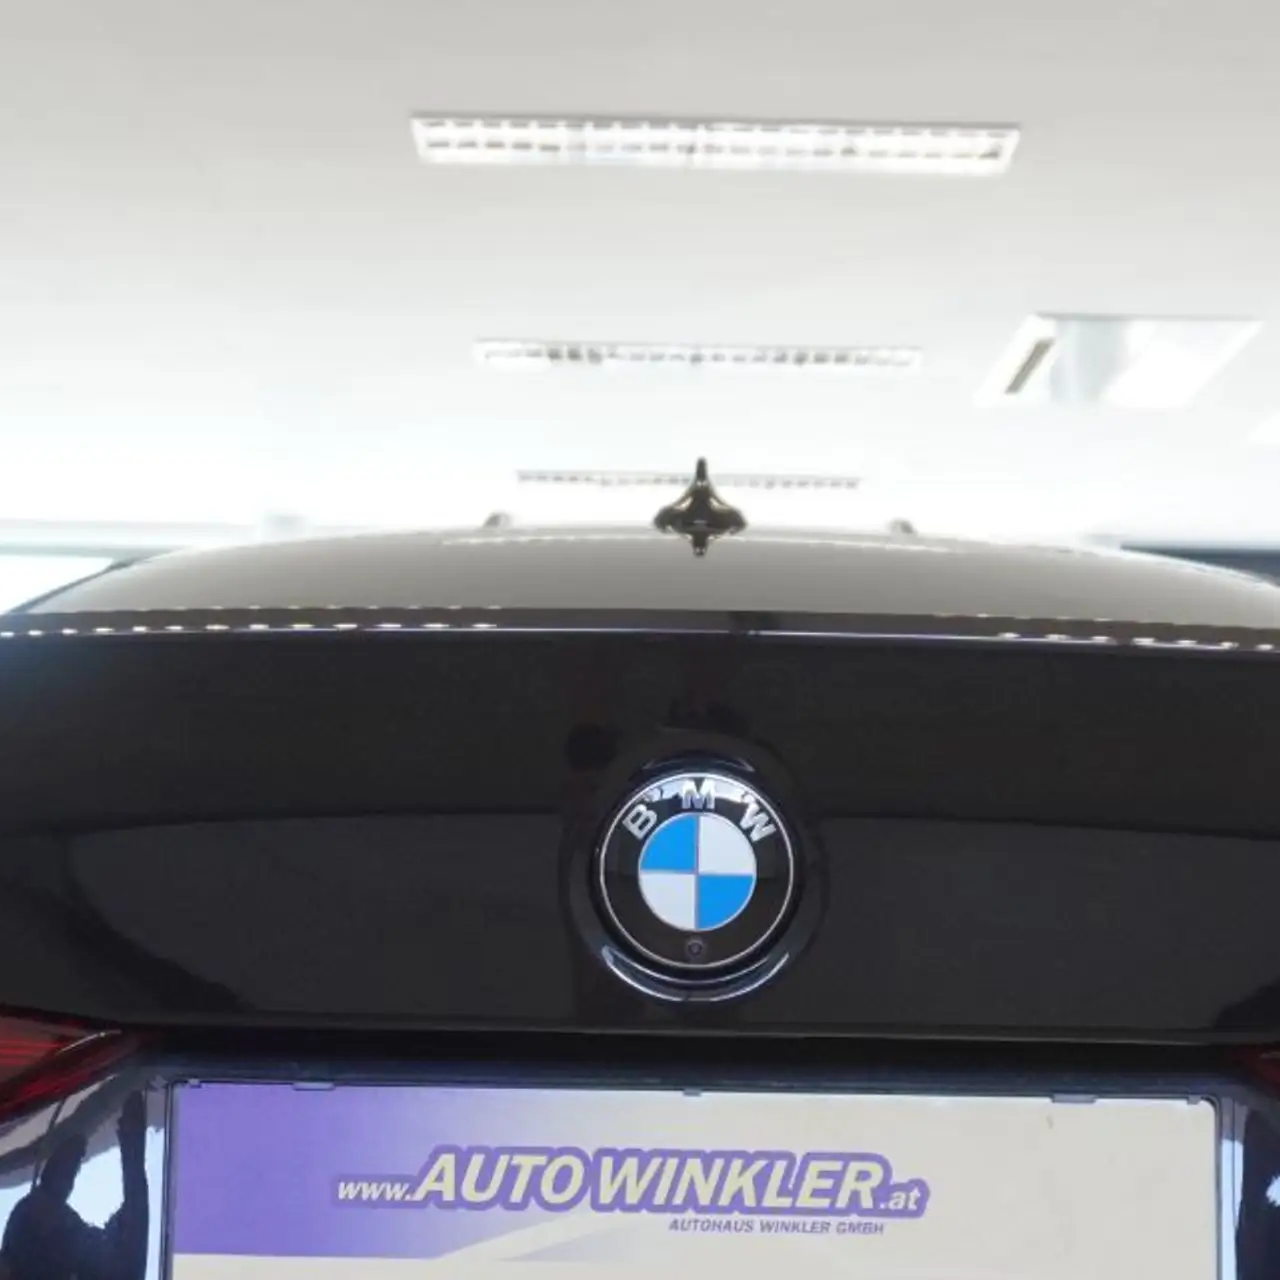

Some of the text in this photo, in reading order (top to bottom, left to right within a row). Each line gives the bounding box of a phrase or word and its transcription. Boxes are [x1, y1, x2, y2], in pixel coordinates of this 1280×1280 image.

[622, 777, 777, 843] BMW
[669, 1218, 754, 1233] AUTOHAUS
[760, 1220, 830, 1234] WINKLER
